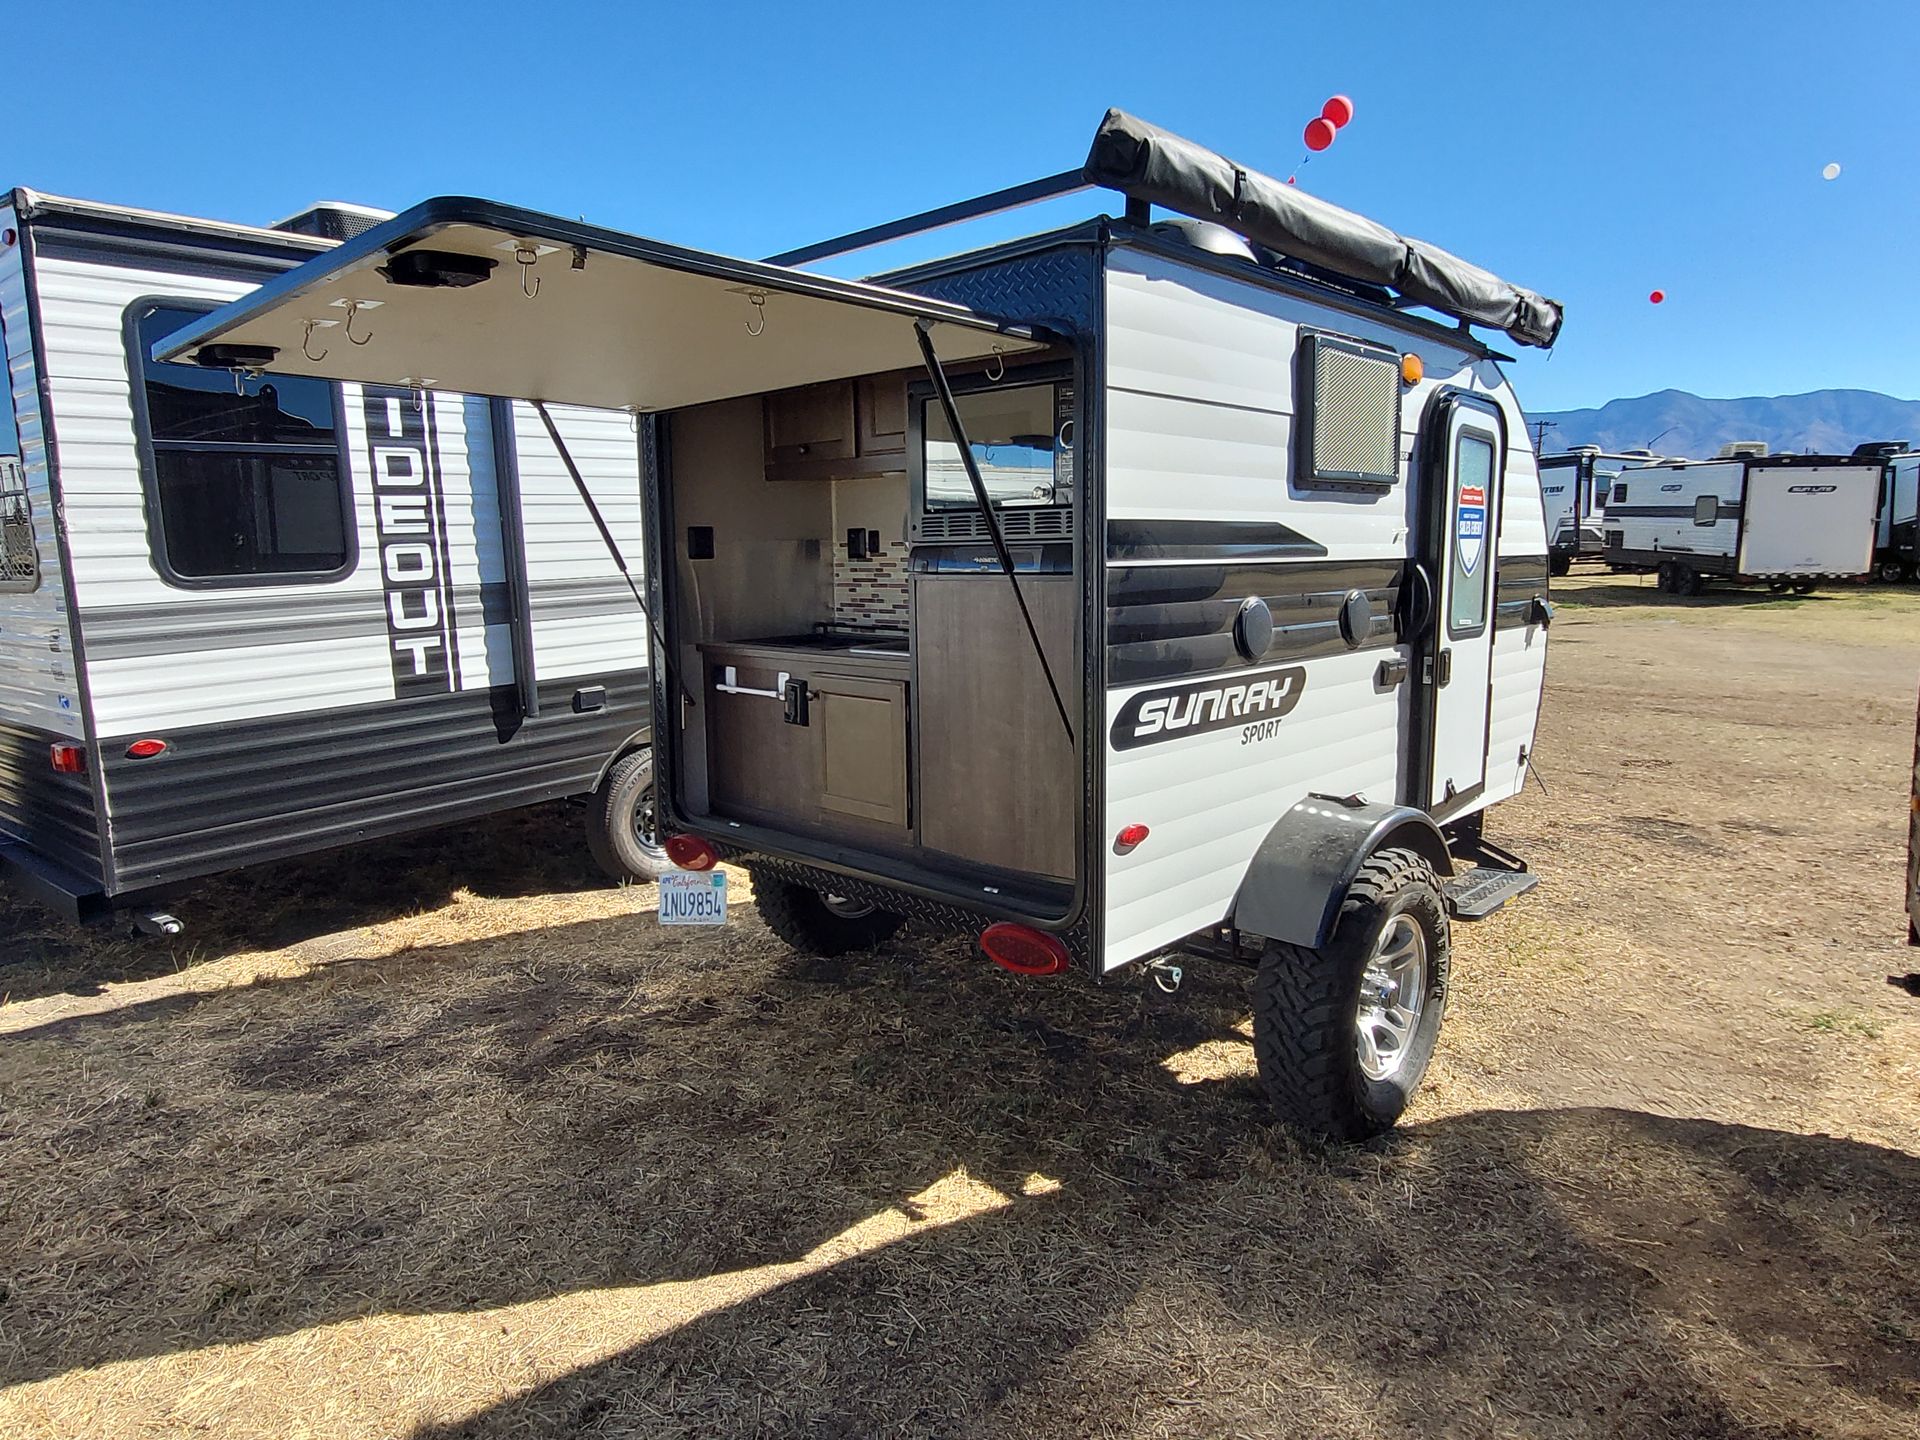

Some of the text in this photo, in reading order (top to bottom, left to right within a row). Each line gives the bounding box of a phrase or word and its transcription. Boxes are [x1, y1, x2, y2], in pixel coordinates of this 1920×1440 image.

[1134, 677, 1293, 737] SUNRAY
[1241, 719, 1283, 746] SPORT
[662, 891, 722, 917] 1NU9854
